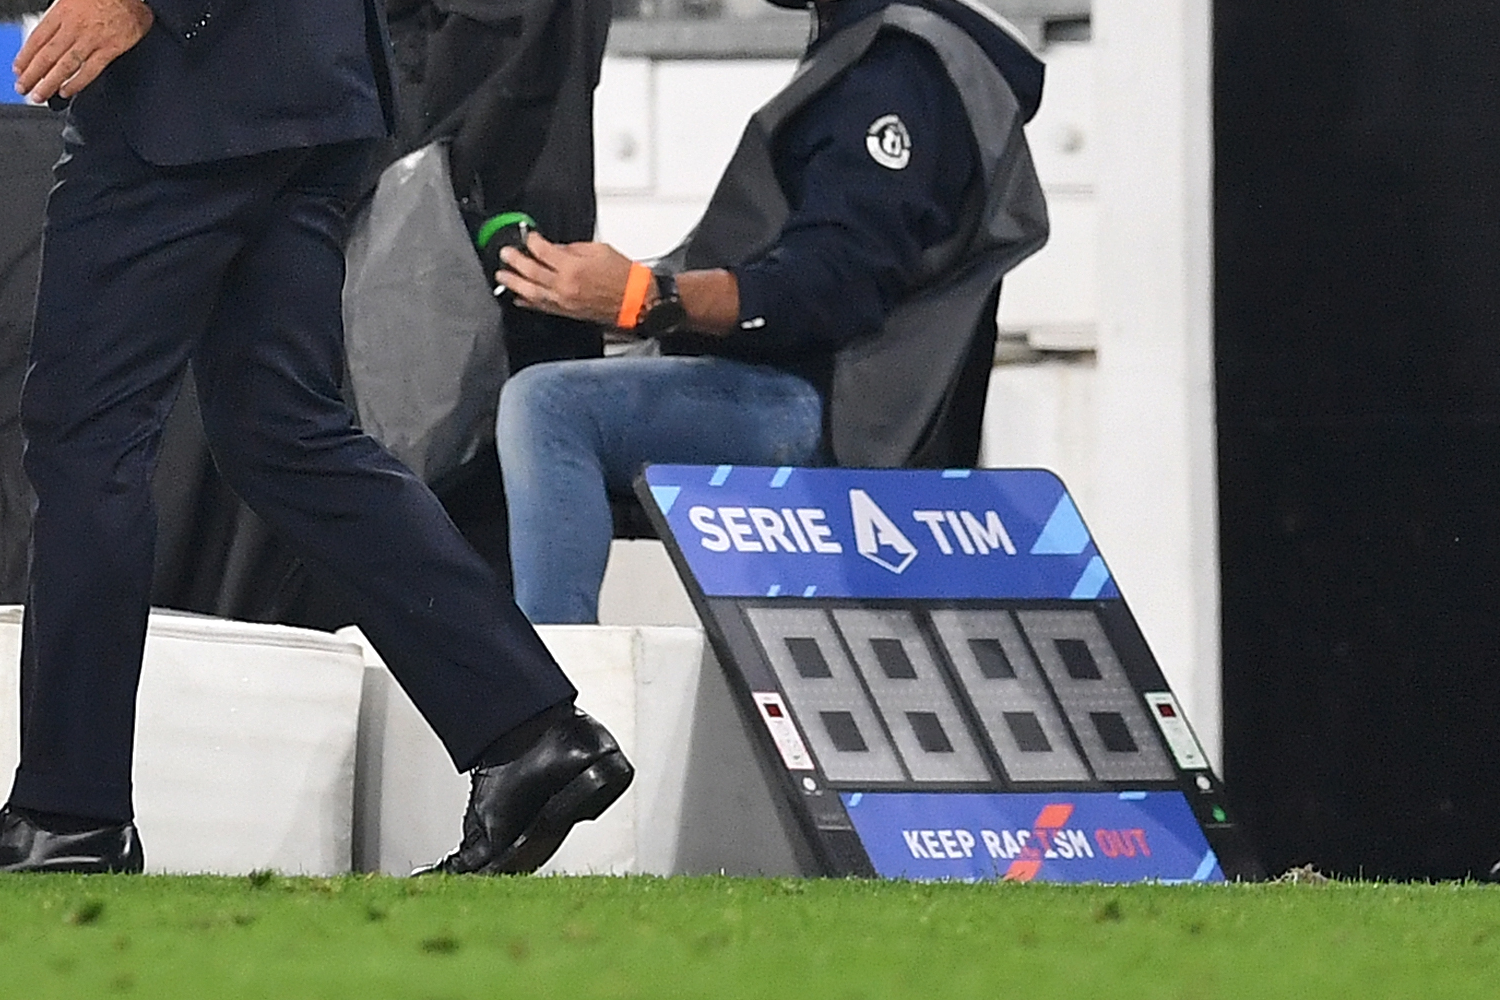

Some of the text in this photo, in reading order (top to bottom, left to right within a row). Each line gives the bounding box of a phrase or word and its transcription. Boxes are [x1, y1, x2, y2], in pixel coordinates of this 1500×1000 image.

[688, 488, 1017, 574] SERIE A TIM
[902, 828, 1151, 860] KEEP RACISM OUT
